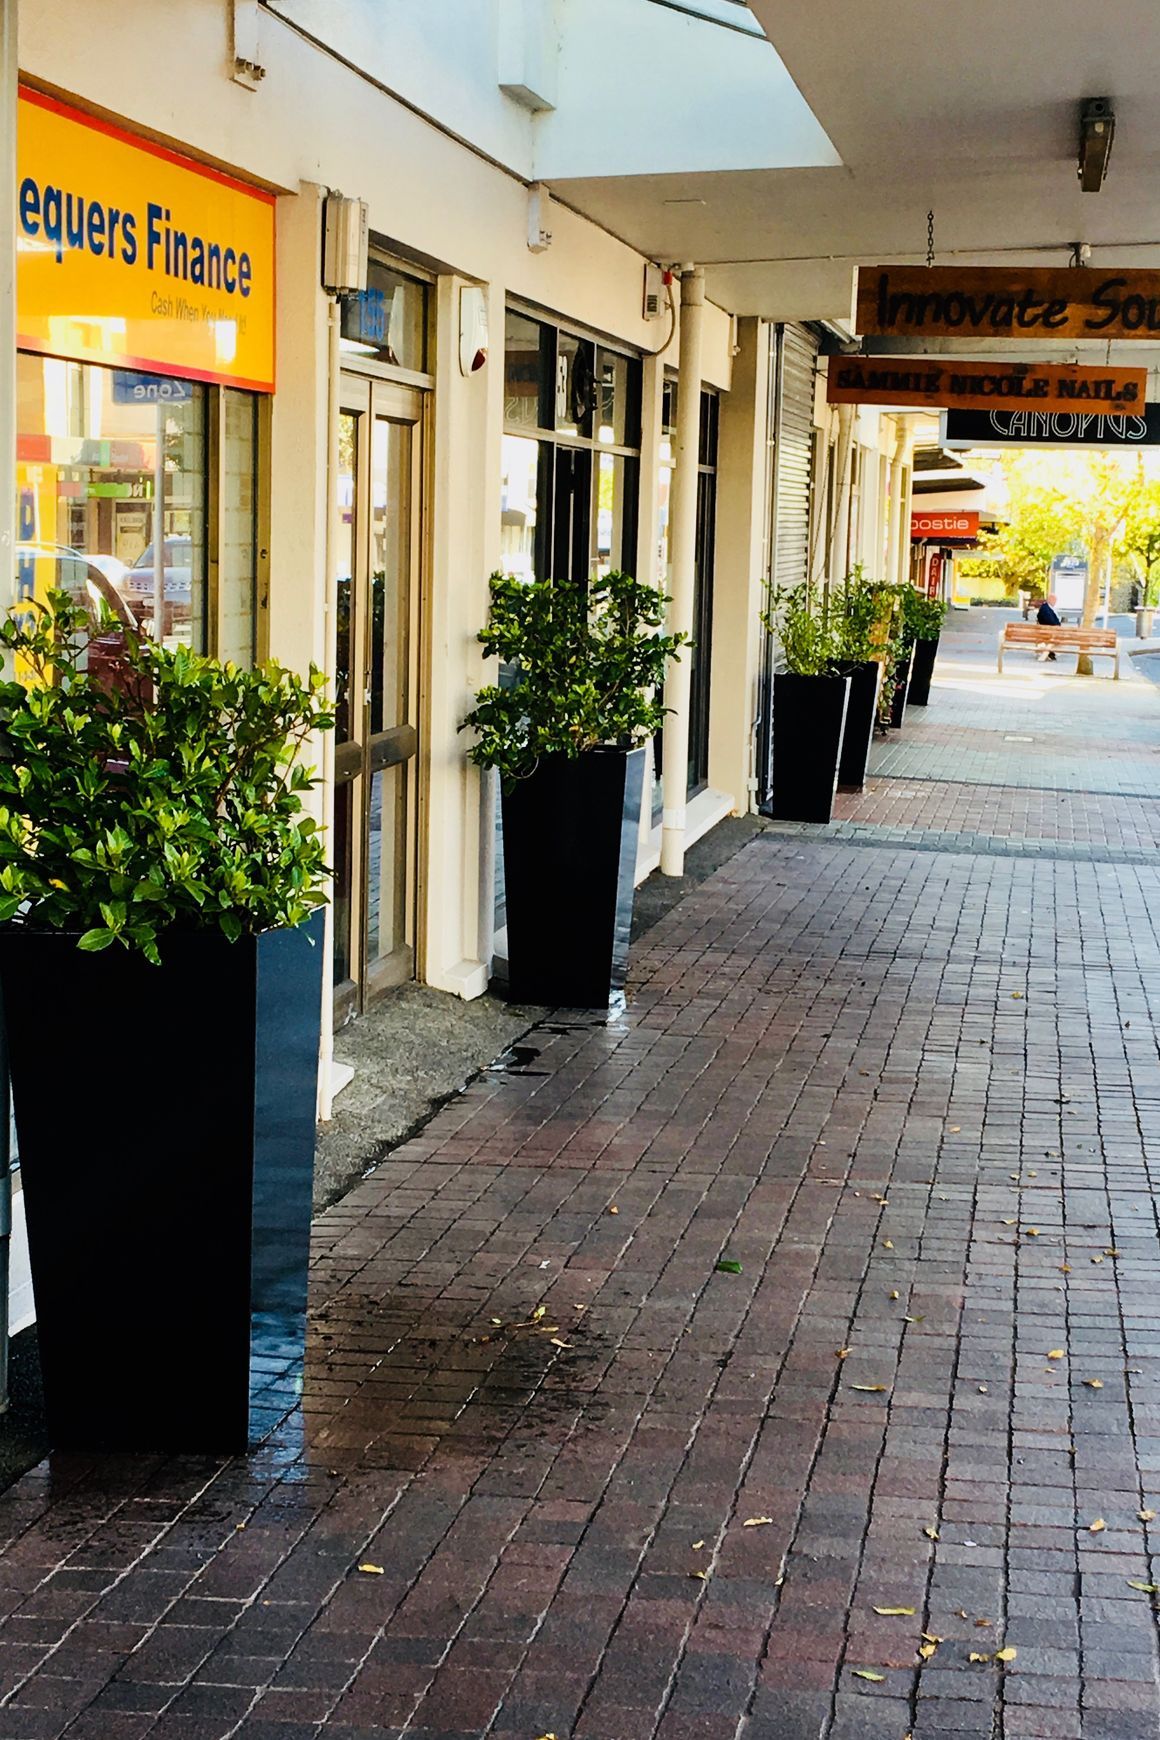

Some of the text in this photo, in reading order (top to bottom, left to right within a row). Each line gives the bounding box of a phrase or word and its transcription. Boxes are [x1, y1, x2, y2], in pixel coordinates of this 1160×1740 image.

[19, 177, 138, 265] equers
[147, 202, 252, 298] Finance
[151, 290, 173, 317] Cash
[175, 297, 199, 321] When
[876, 273, 1069, 329] Innovate
[837, 367, 1138, 404] SAMMIE NICOLE NAILS
